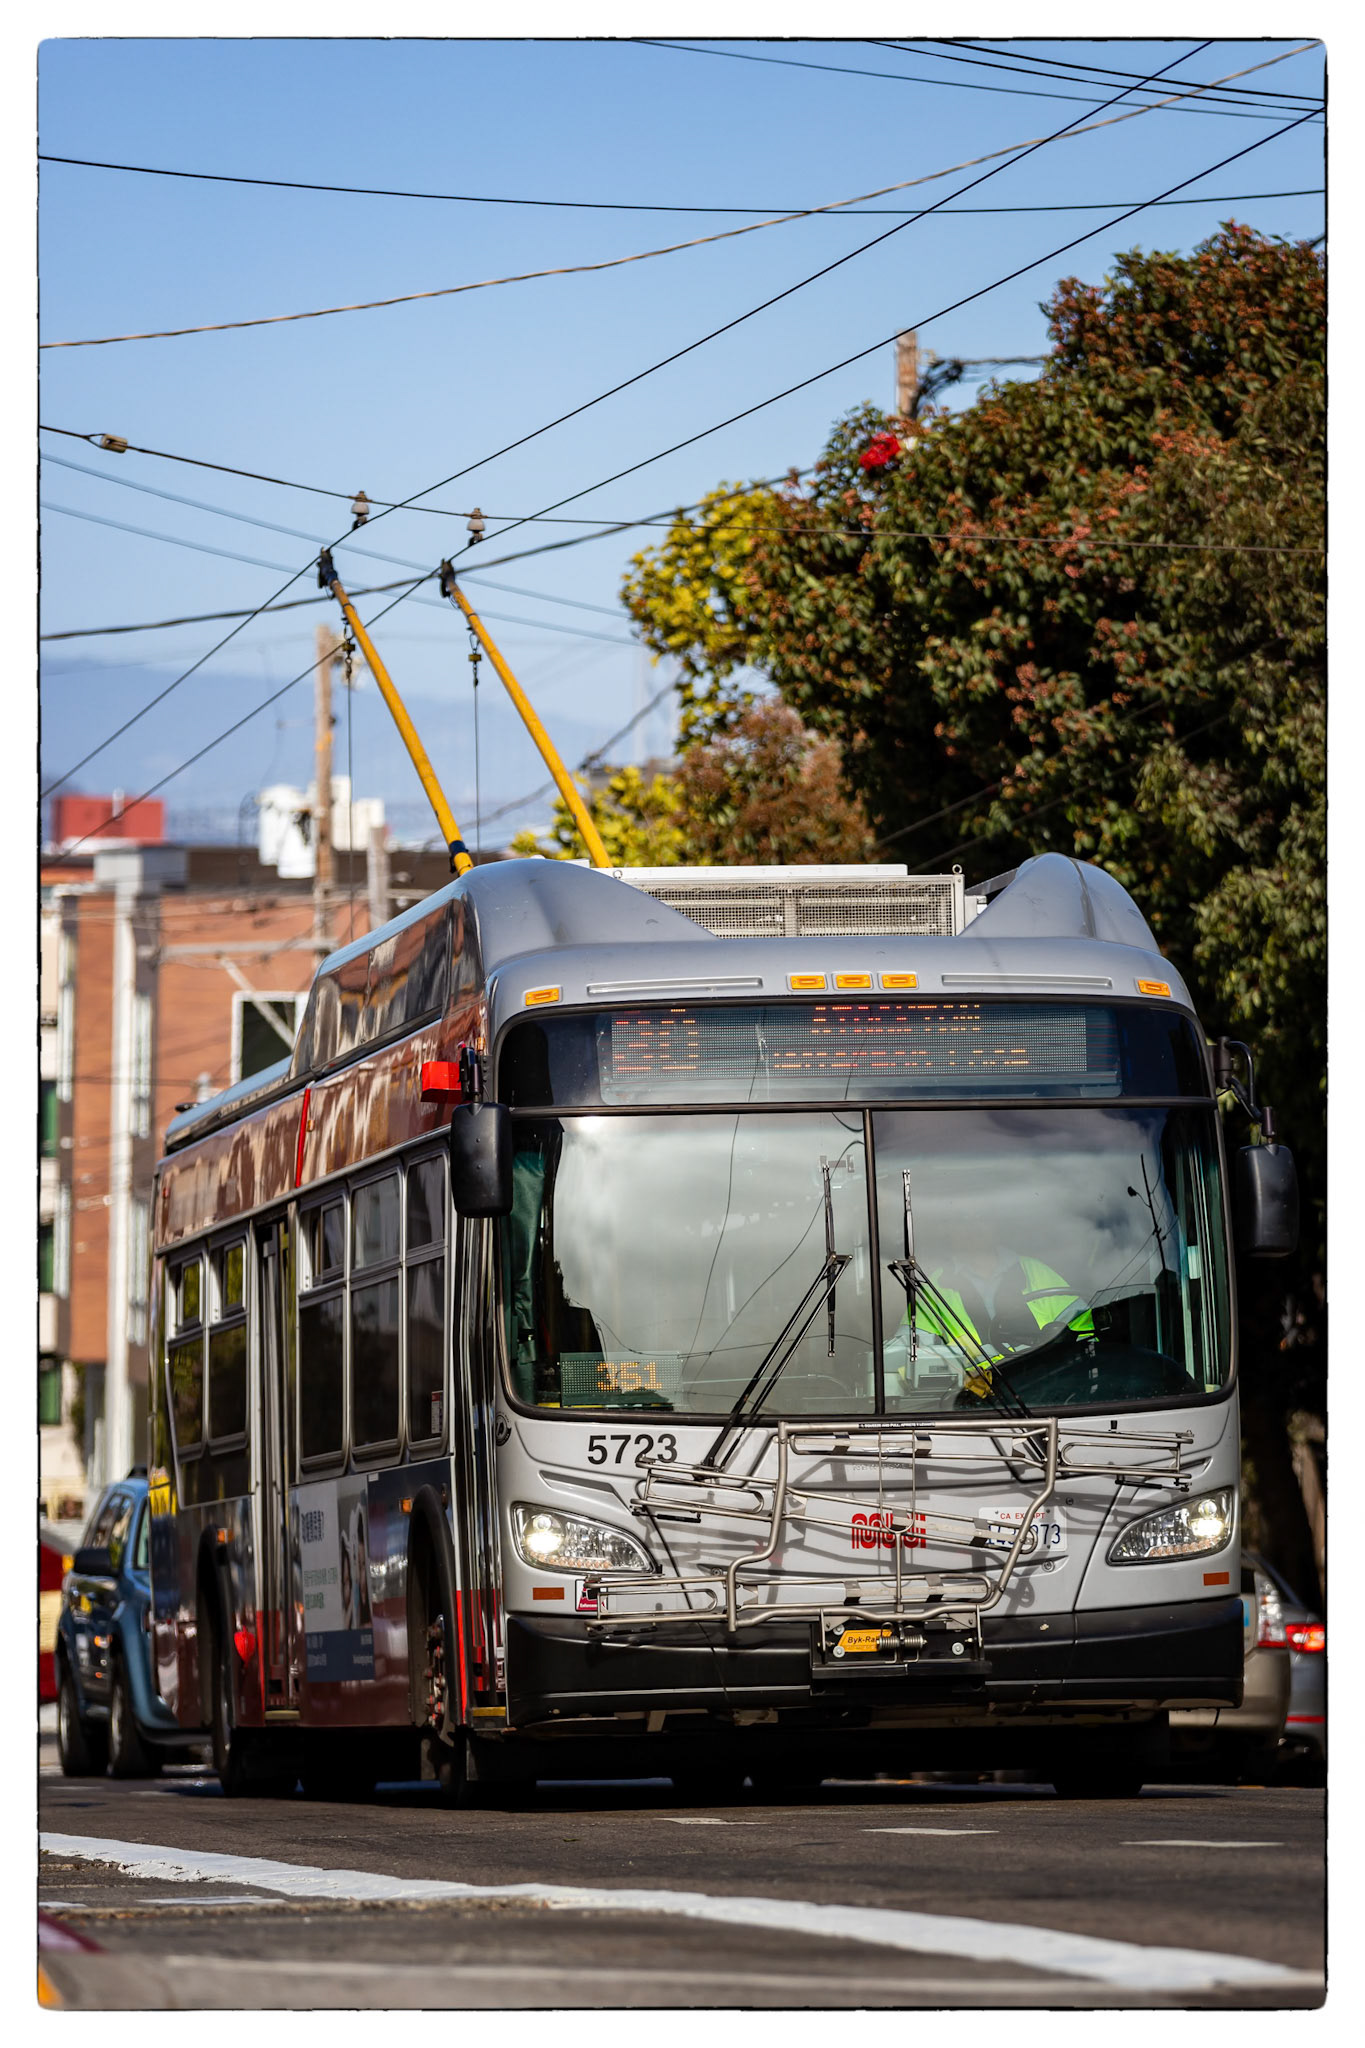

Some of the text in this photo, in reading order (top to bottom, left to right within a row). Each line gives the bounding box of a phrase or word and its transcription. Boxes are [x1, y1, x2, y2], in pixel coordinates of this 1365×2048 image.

[597, 1361, 662, 1391] 351
[587, 1433, 678, 1465] 5723
[1000, 1512, 1046, 1520] CA EXPT
